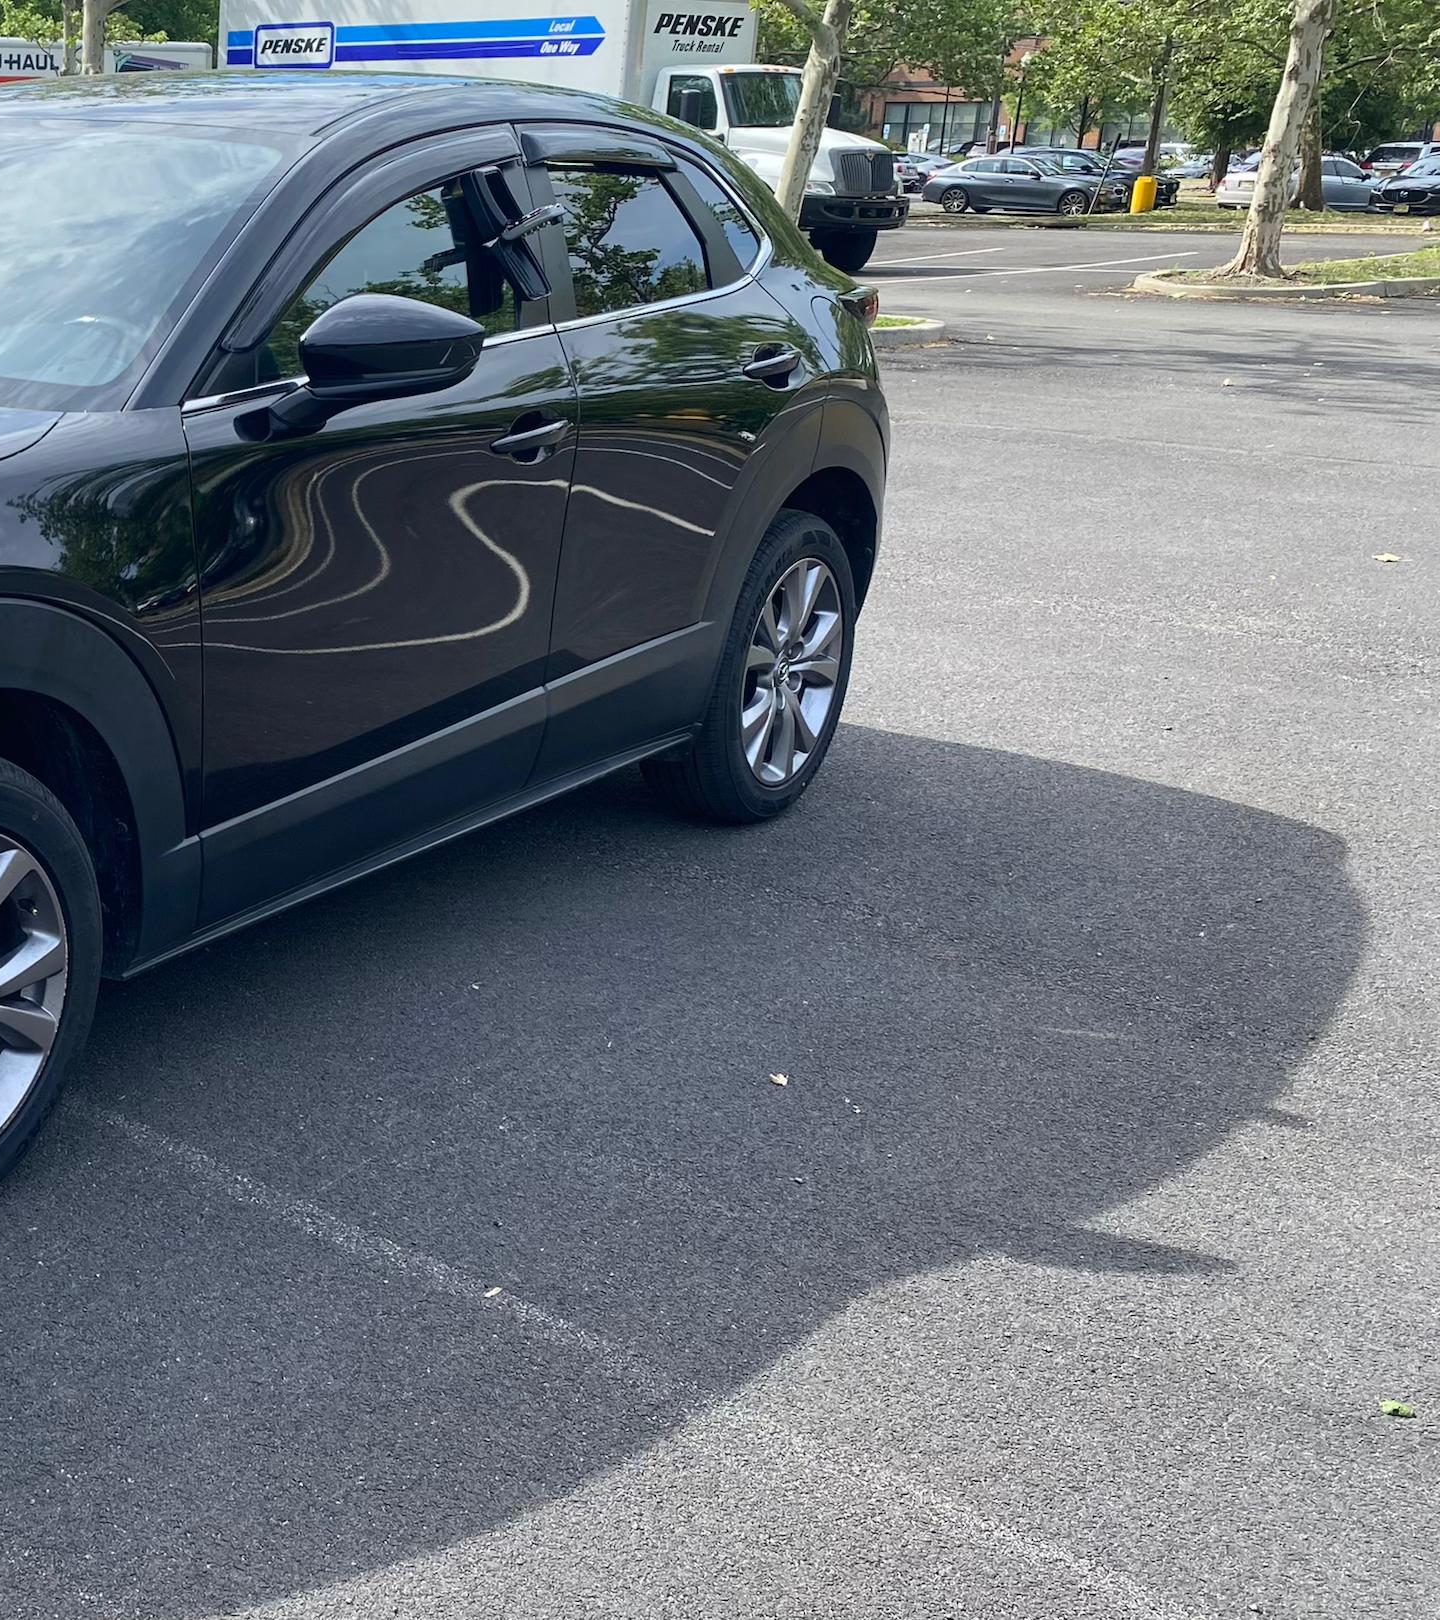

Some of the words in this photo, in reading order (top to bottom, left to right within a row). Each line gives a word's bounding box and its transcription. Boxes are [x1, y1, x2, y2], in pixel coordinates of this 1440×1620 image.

[548, 19, 576, 33] Local
[653, 13, 744, 37] PENSKE
[260, 37, 328, 54] PENSKE
[540, 41, 559, 54] One
[558, 40, 581, 55] Way
[672, 39, 695, 51] Truck
[696, 40, 725, 53] Rental
